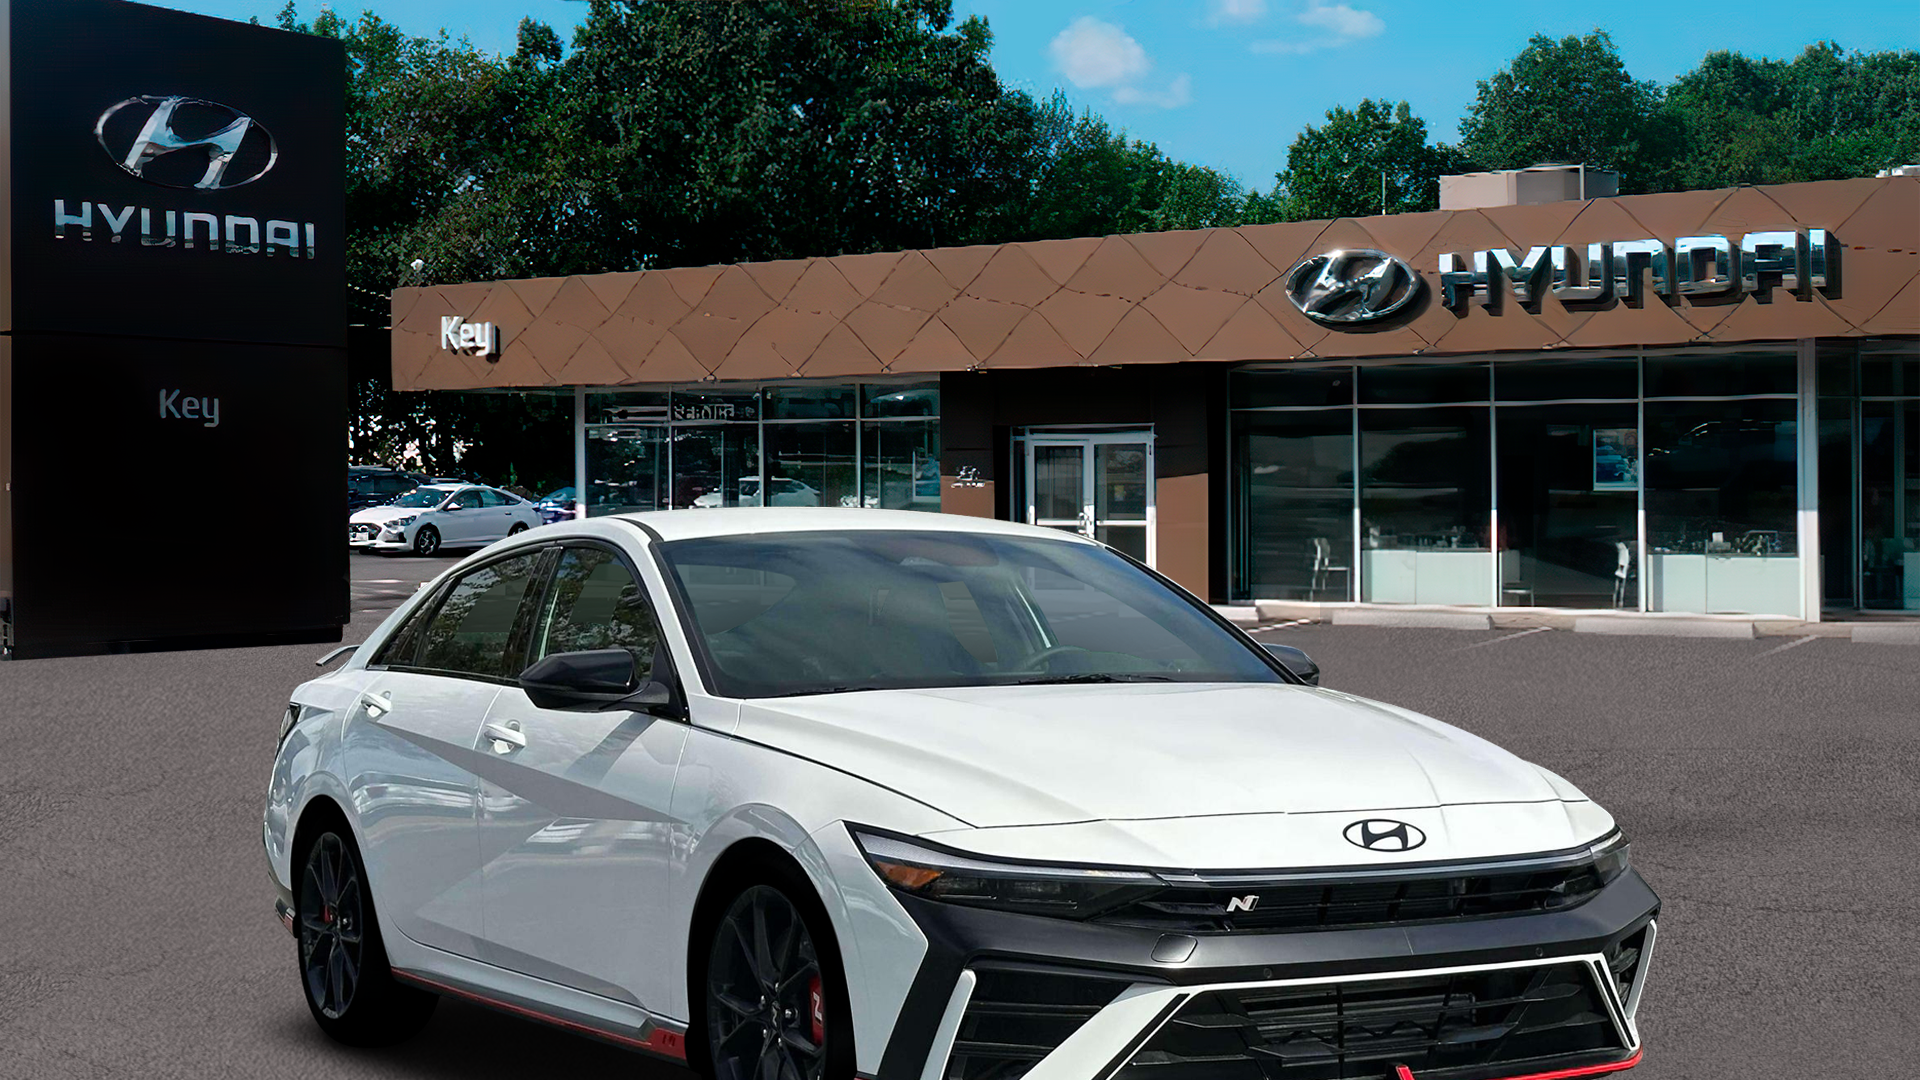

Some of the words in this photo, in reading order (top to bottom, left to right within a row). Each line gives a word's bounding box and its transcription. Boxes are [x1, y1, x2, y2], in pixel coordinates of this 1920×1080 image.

[54, 199, 315, 260] HYUNDAI
[1437, 228, 1840, 314] HYUNDAI
[441, 315, 493, 357] Key
[159, 388, 220, 428] Key
